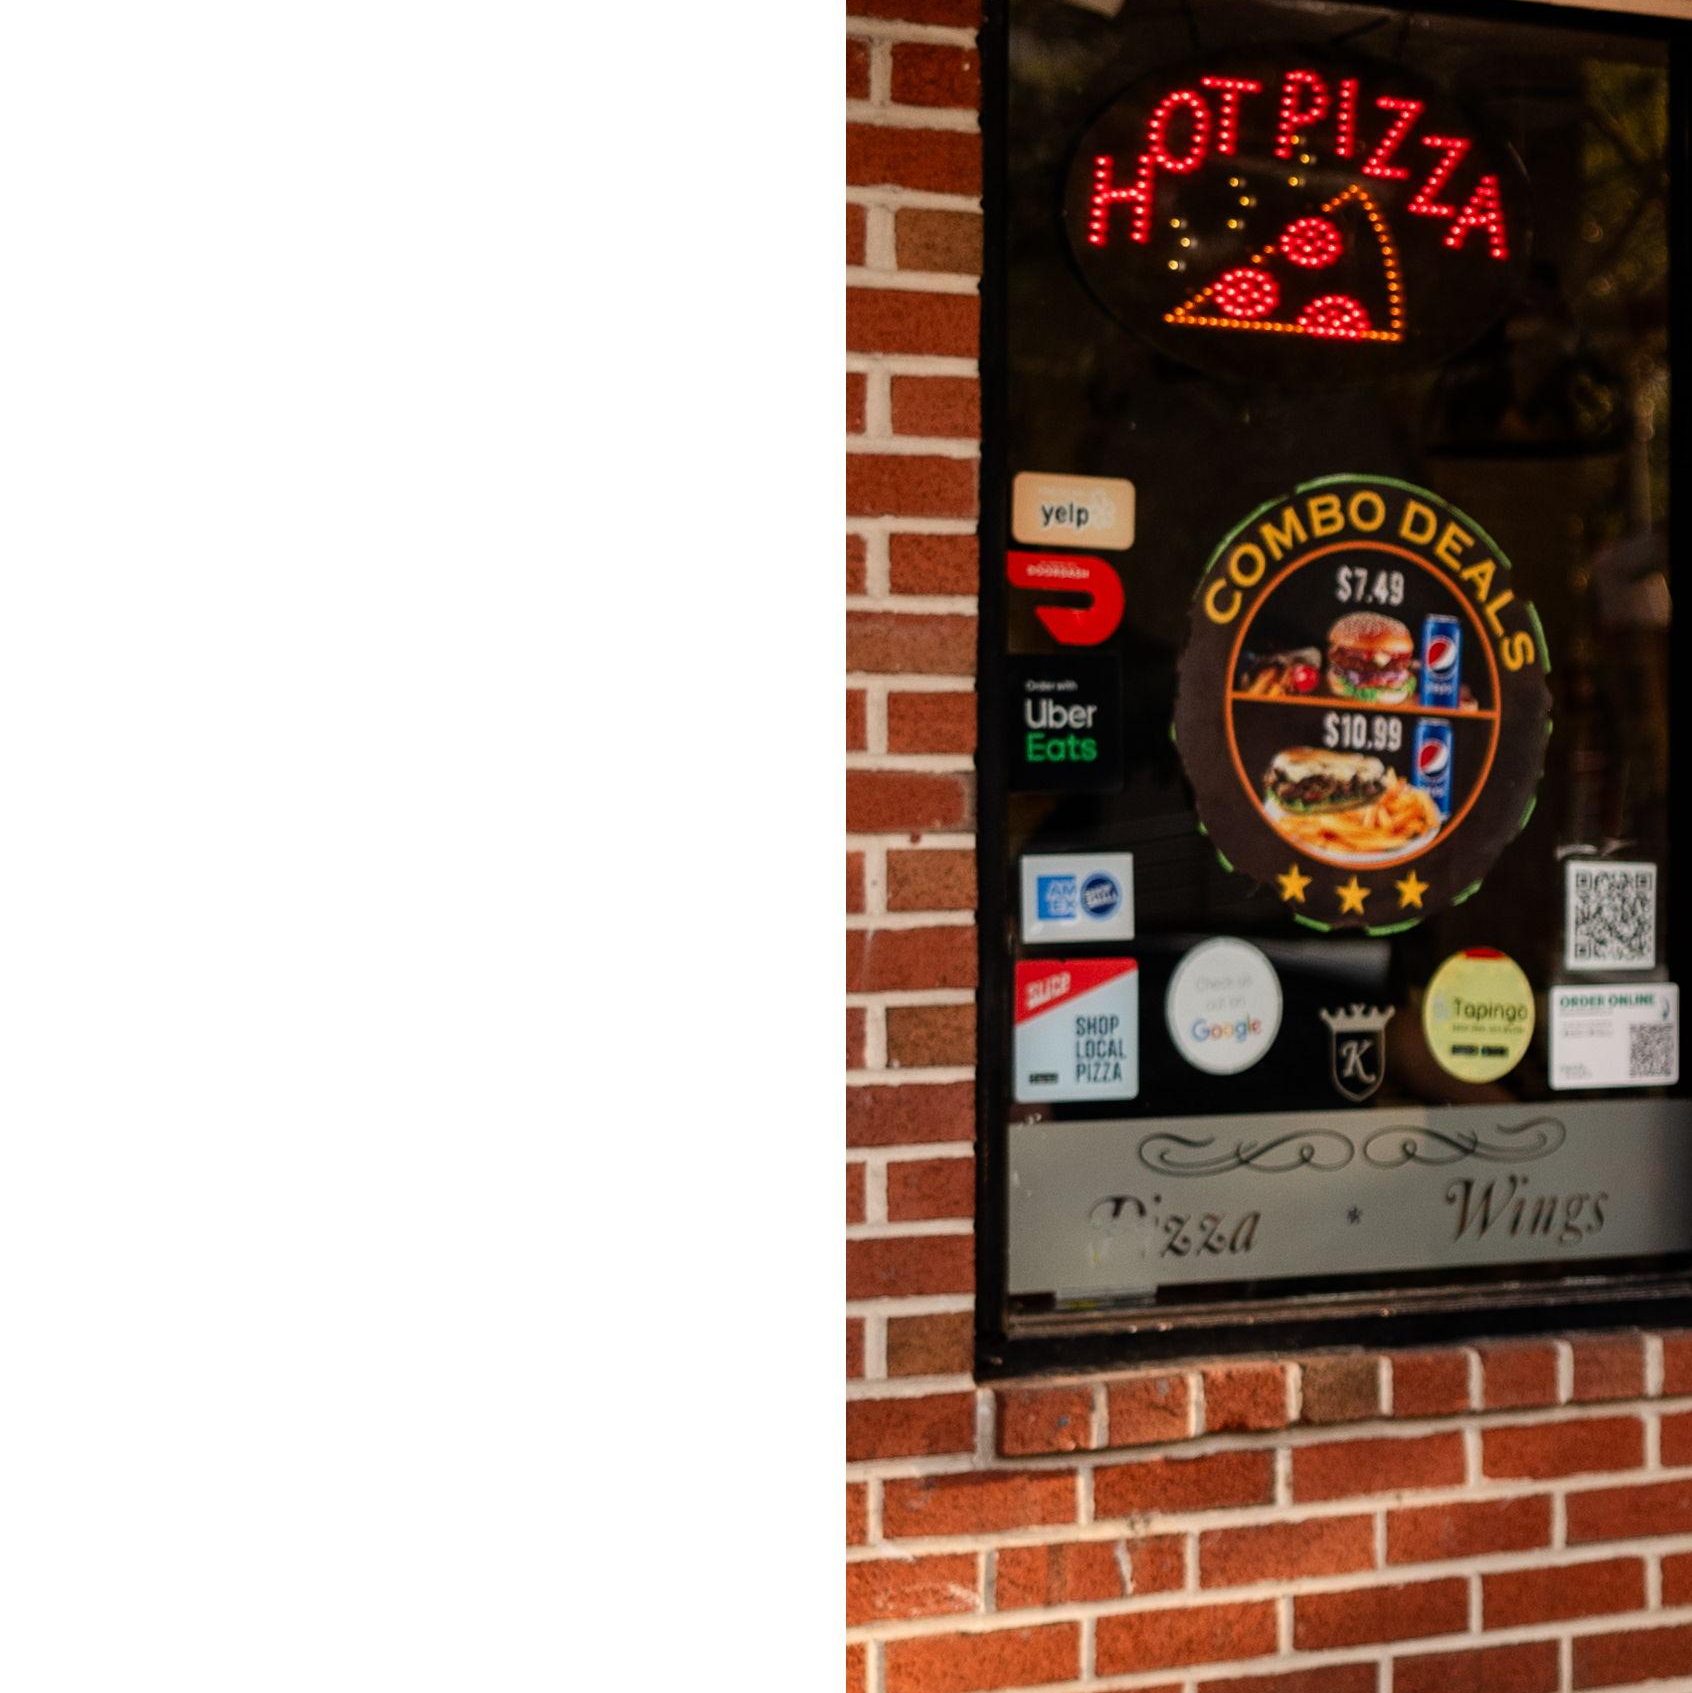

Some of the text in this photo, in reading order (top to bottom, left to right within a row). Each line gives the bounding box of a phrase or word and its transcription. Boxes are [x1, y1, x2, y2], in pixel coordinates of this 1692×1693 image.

[1088, 69, 1509, 260] HOT PIZZA
[1041, 501, 1090, 530] yelp
[1203, 489, 1536, 673] COMBO DEALS
[1336, 564, 1406, 607] $7.49
[1025, 697, 1098, 729] Uber
[1026, 732, 1098, 762] Eats
[1322, 711, 1402, 753] $10.99
[1453, 996, 1529, 1022] Tapingo
[1560, 993, 1656, 1008] ORDER ONLINE
[1075, 1014, 1119, 1037] SHOP
[1191, 1014, 1263, 1043] Google
[1075, 1038, 1127, 1060] LOCAL
[1341, 1038, 1377, 1085] K
[1076, 1062, 1123, 1084] PIZZA
[1444, 1174, 1609, 1247] Wings
